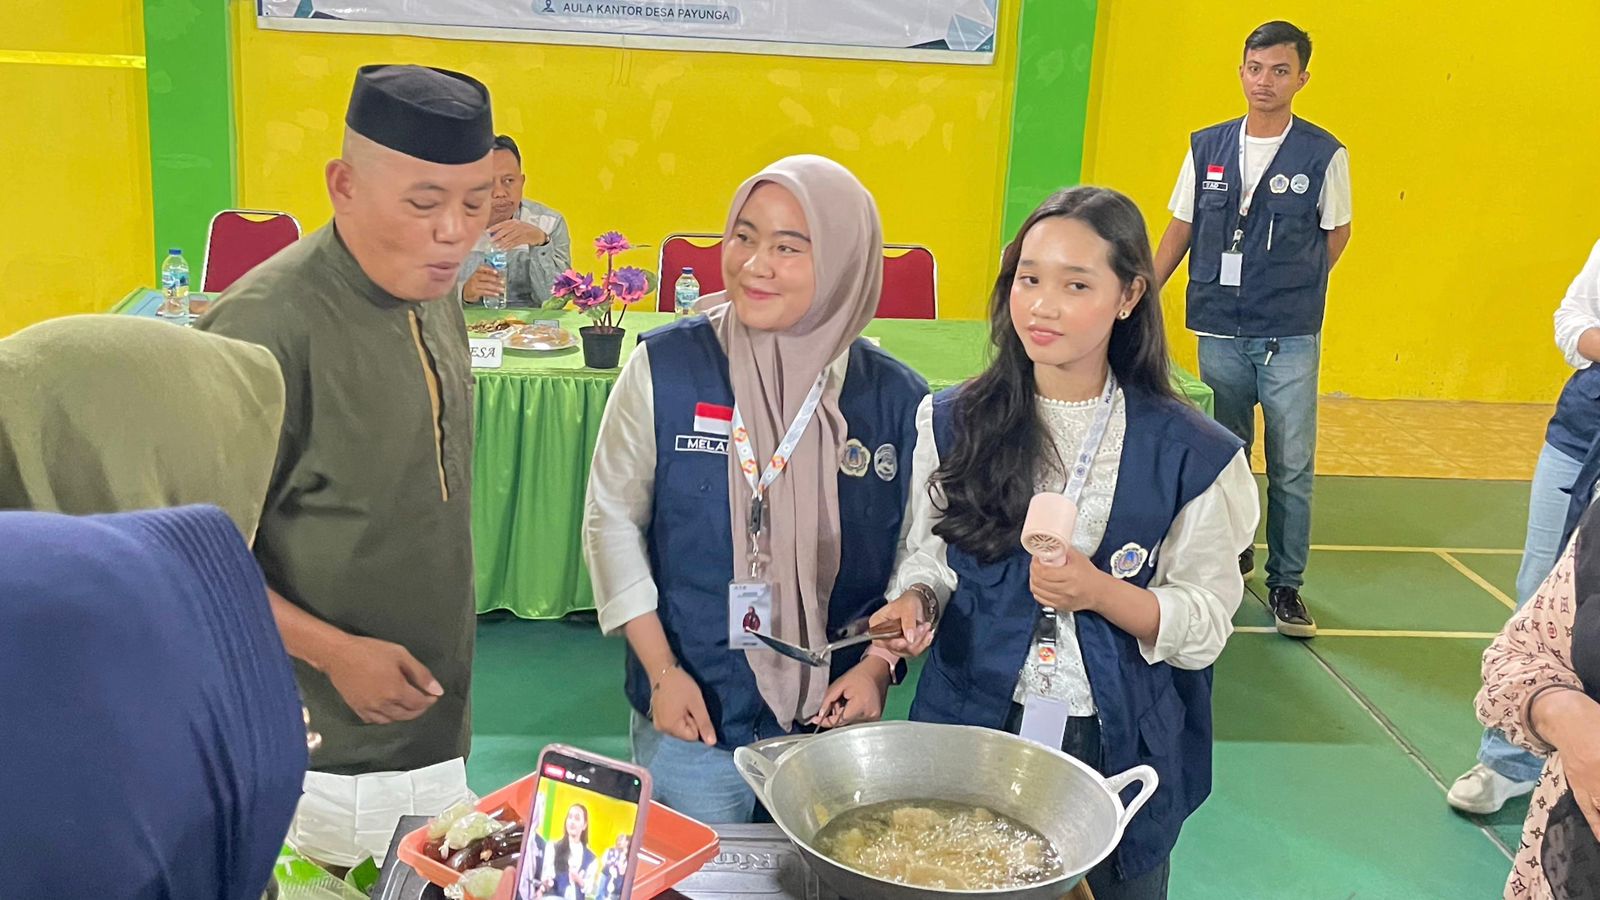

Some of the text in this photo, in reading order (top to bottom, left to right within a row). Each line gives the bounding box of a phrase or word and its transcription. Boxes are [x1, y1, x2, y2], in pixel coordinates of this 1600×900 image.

[563, 2, 730, 21] AULA KANTOR DESA PAYUNGA
